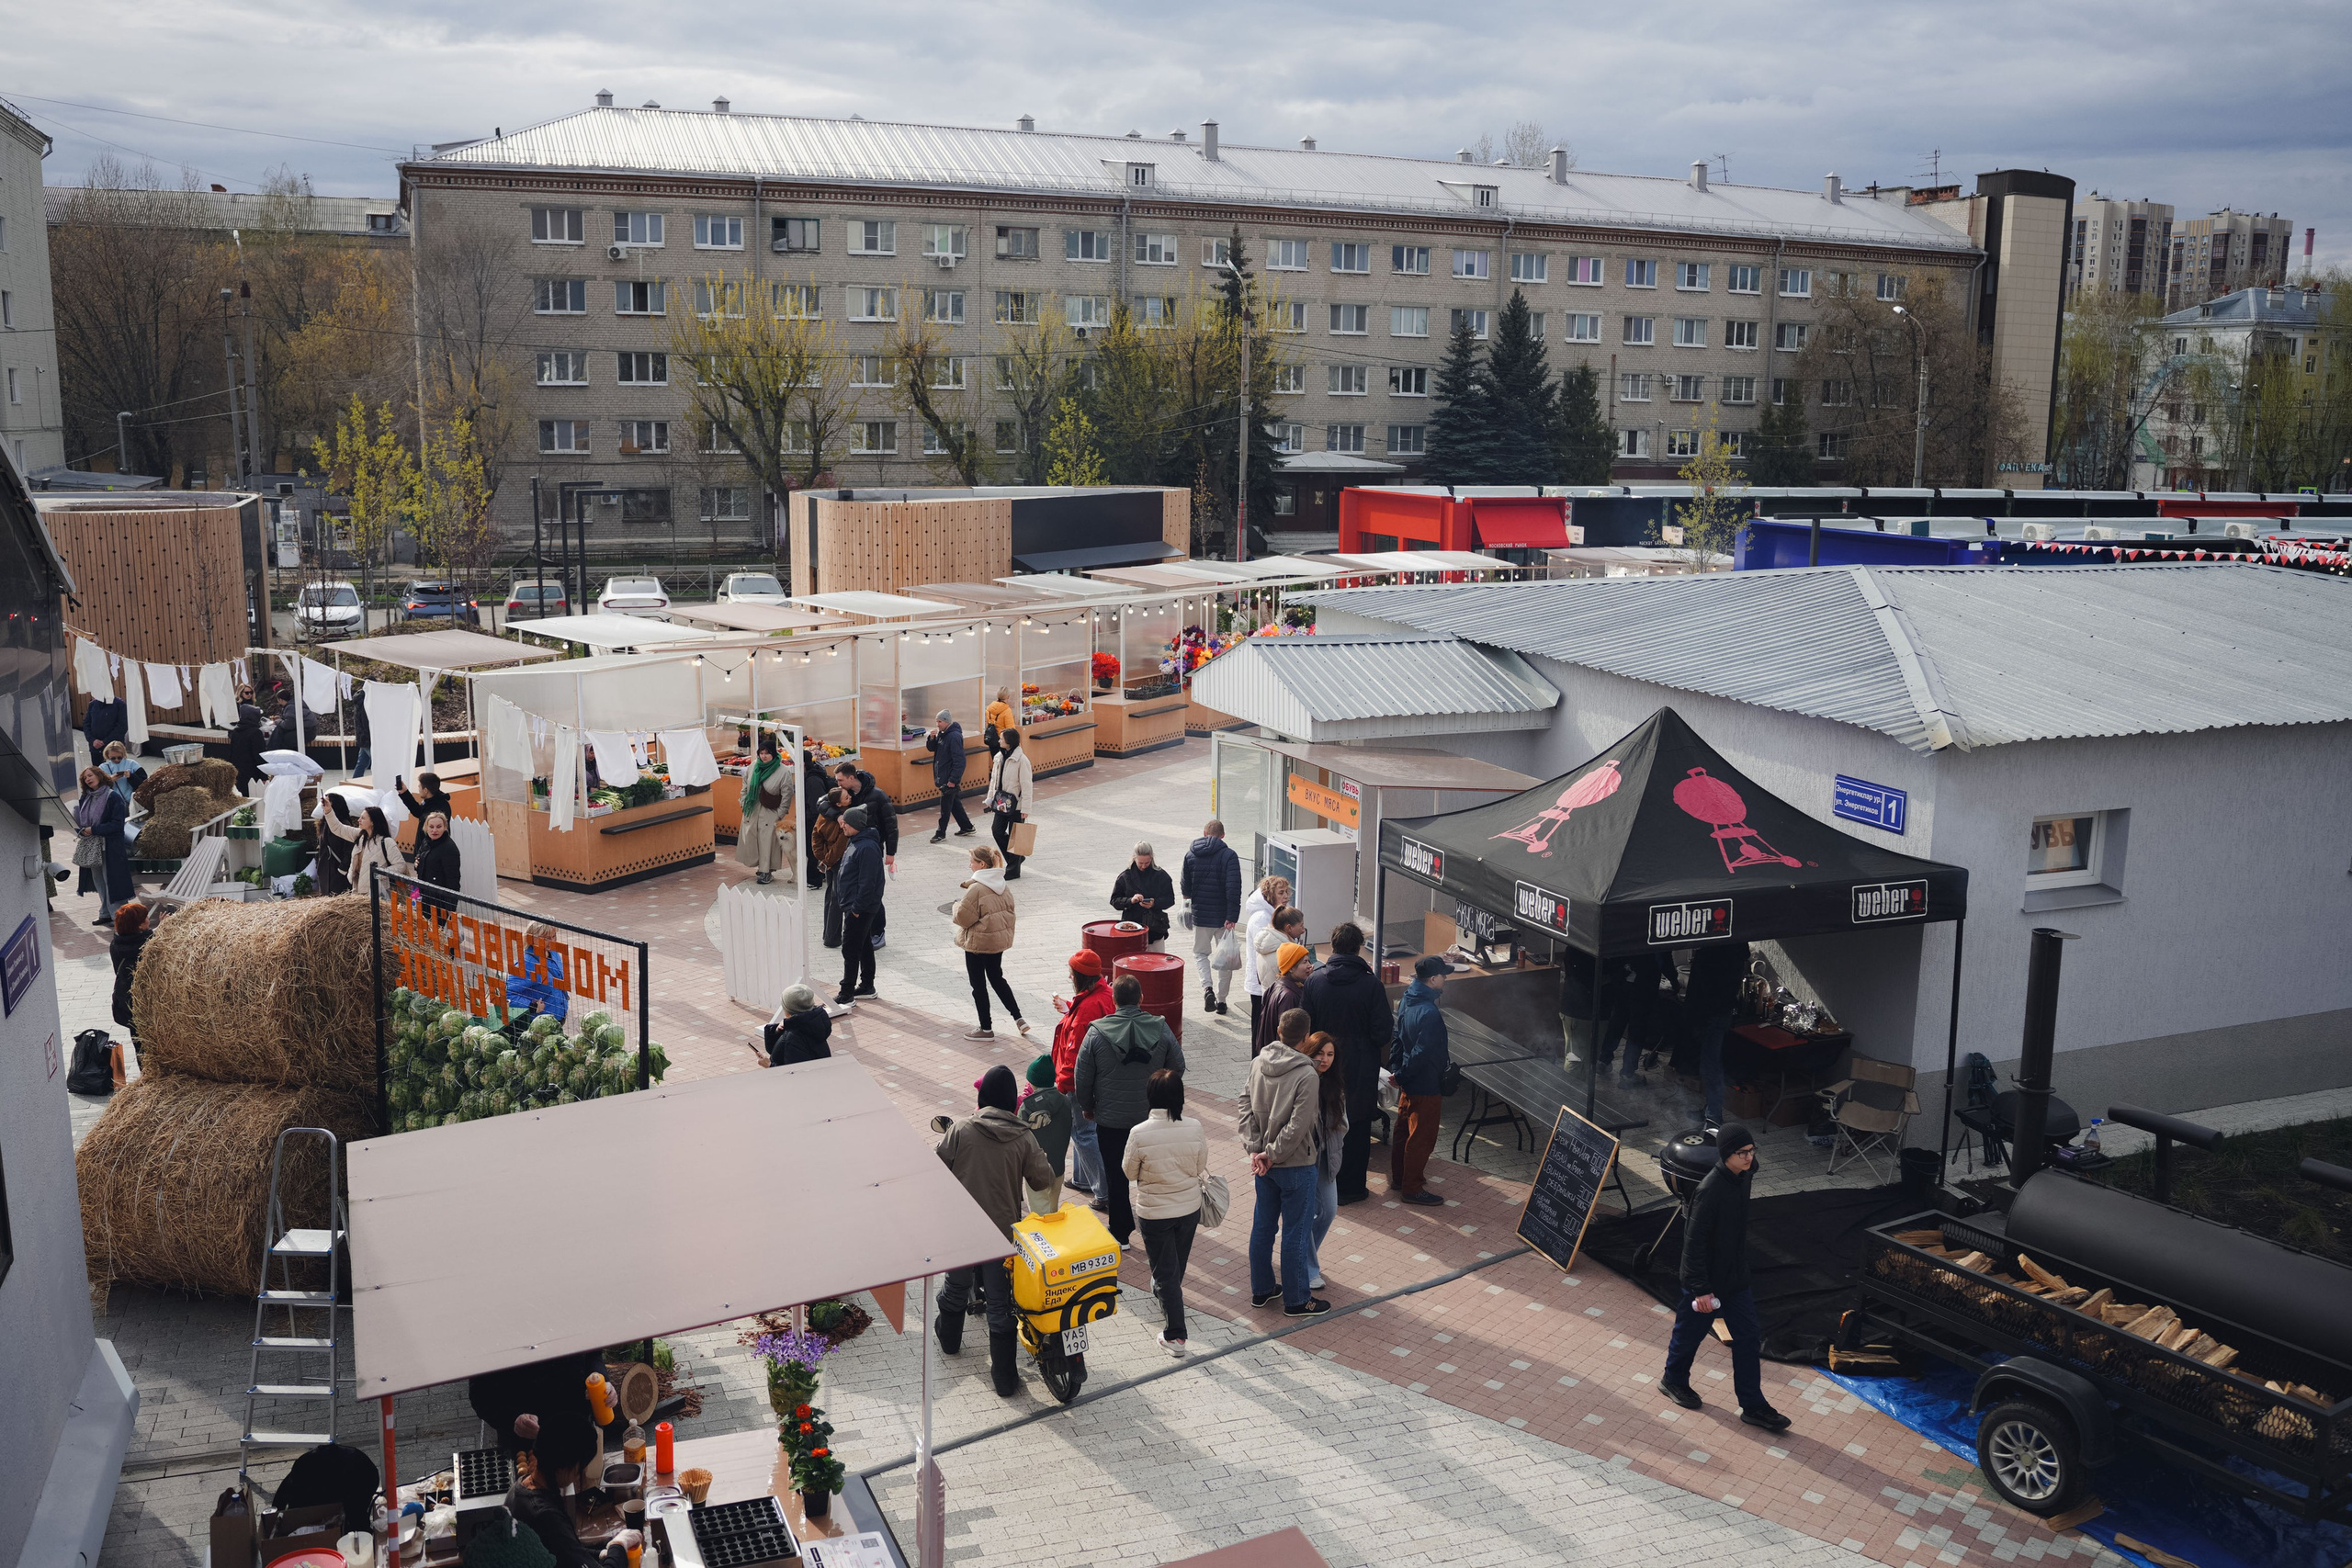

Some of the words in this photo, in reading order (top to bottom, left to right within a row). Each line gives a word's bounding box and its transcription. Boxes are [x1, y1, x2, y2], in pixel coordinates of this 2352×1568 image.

[1341, 781, 1359, 795] ОБУВЬ
[1836, 784, 1873, 802] Энергетиклар
[1873, 795, 1882, 804] ур.
[1305, 789, 1320, 805] ВКУС
[1324, 796, 1340, 813] МЯСА
[1844, 799, 1879, 815] Энергетиков
[1888, 799, 1897, 823] 1
[1404, 841, 1433, 875] weber
[1519, 887, 1555, 925] weber
[1858, 886, 1909, 918] weber
[1456, 901, 1474, 930] ВКУС
[1656, 904, 1712, 938] weber
[30, 933, 37, 966] 1
[1046, 1285, 1077, 1297] Яндекс
[1046, 1296, 1061, 1306] Еда
[1067, 1339, 1086, 1352] 190
